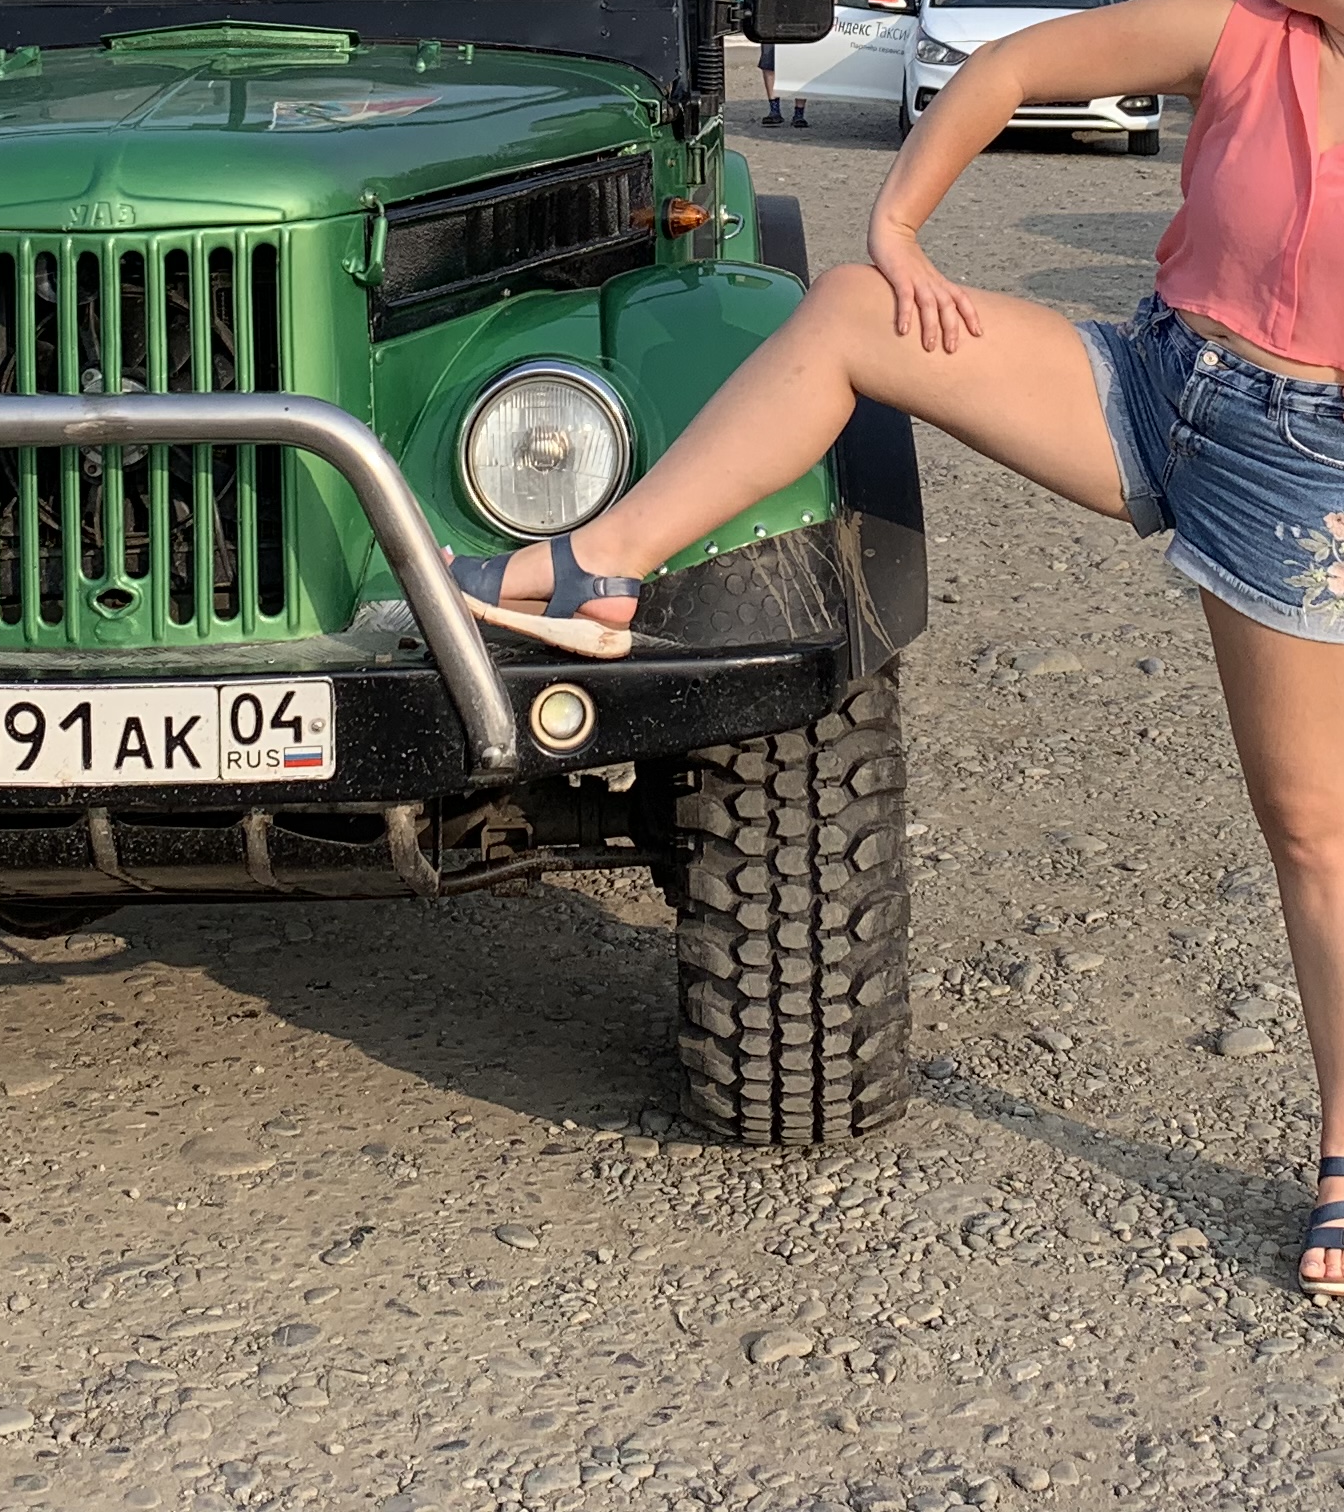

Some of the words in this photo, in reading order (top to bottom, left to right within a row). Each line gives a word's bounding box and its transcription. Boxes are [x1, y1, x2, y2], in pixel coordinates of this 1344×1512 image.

[876, 21, 908, 41] Такси
[230, 690, 303, 745] 04
[227, 749, 281, 769] RUS
